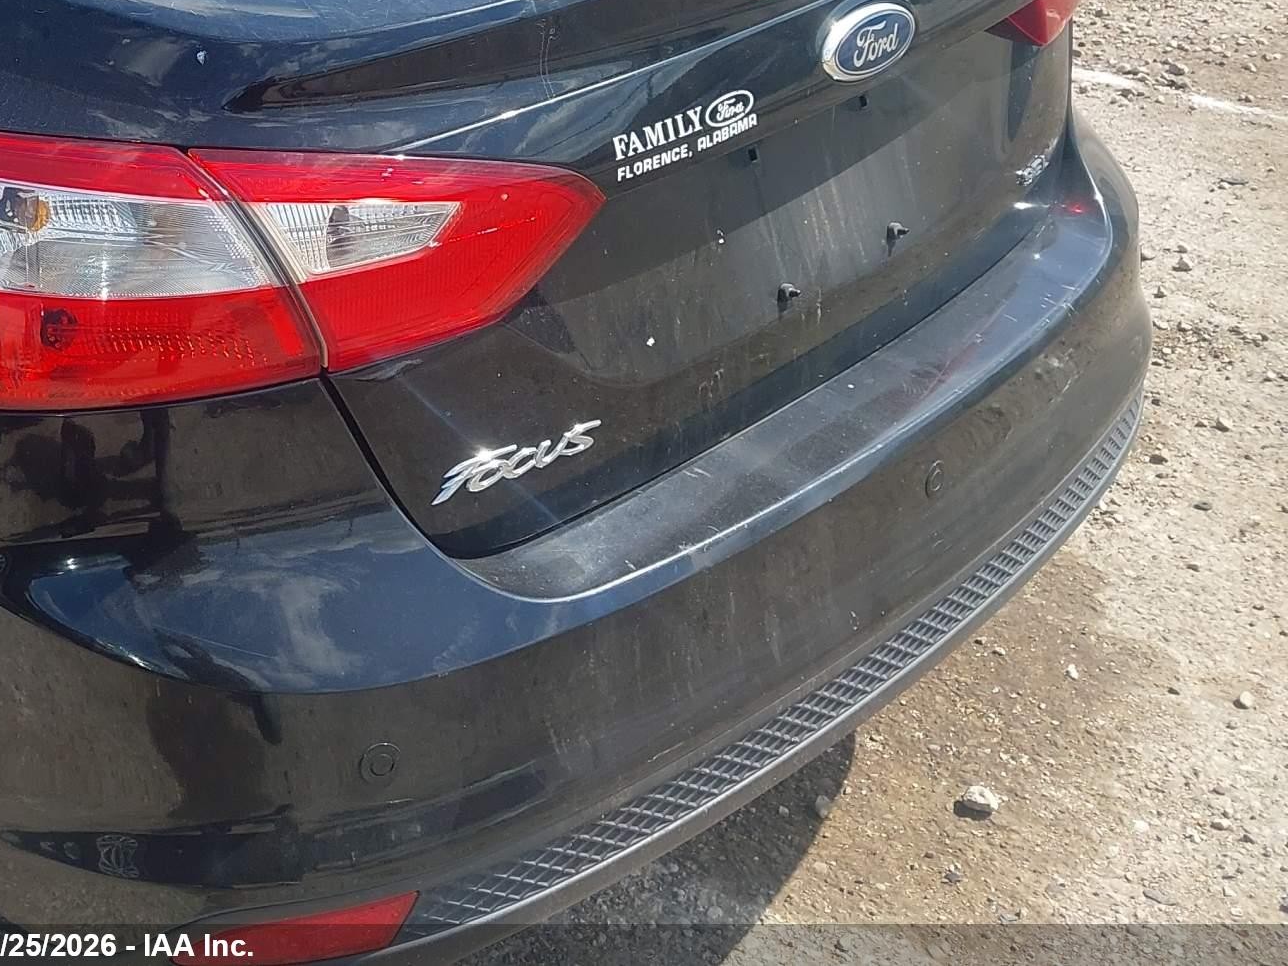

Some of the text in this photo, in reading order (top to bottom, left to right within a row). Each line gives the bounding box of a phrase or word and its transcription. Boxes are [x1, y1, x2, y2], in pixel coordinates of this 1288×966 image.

[853, 20, 899, 68] Ford
[612, 106, 704, 161] FAMILY
[617, 113, 758, 182] FLORENCE, ALABAMA
